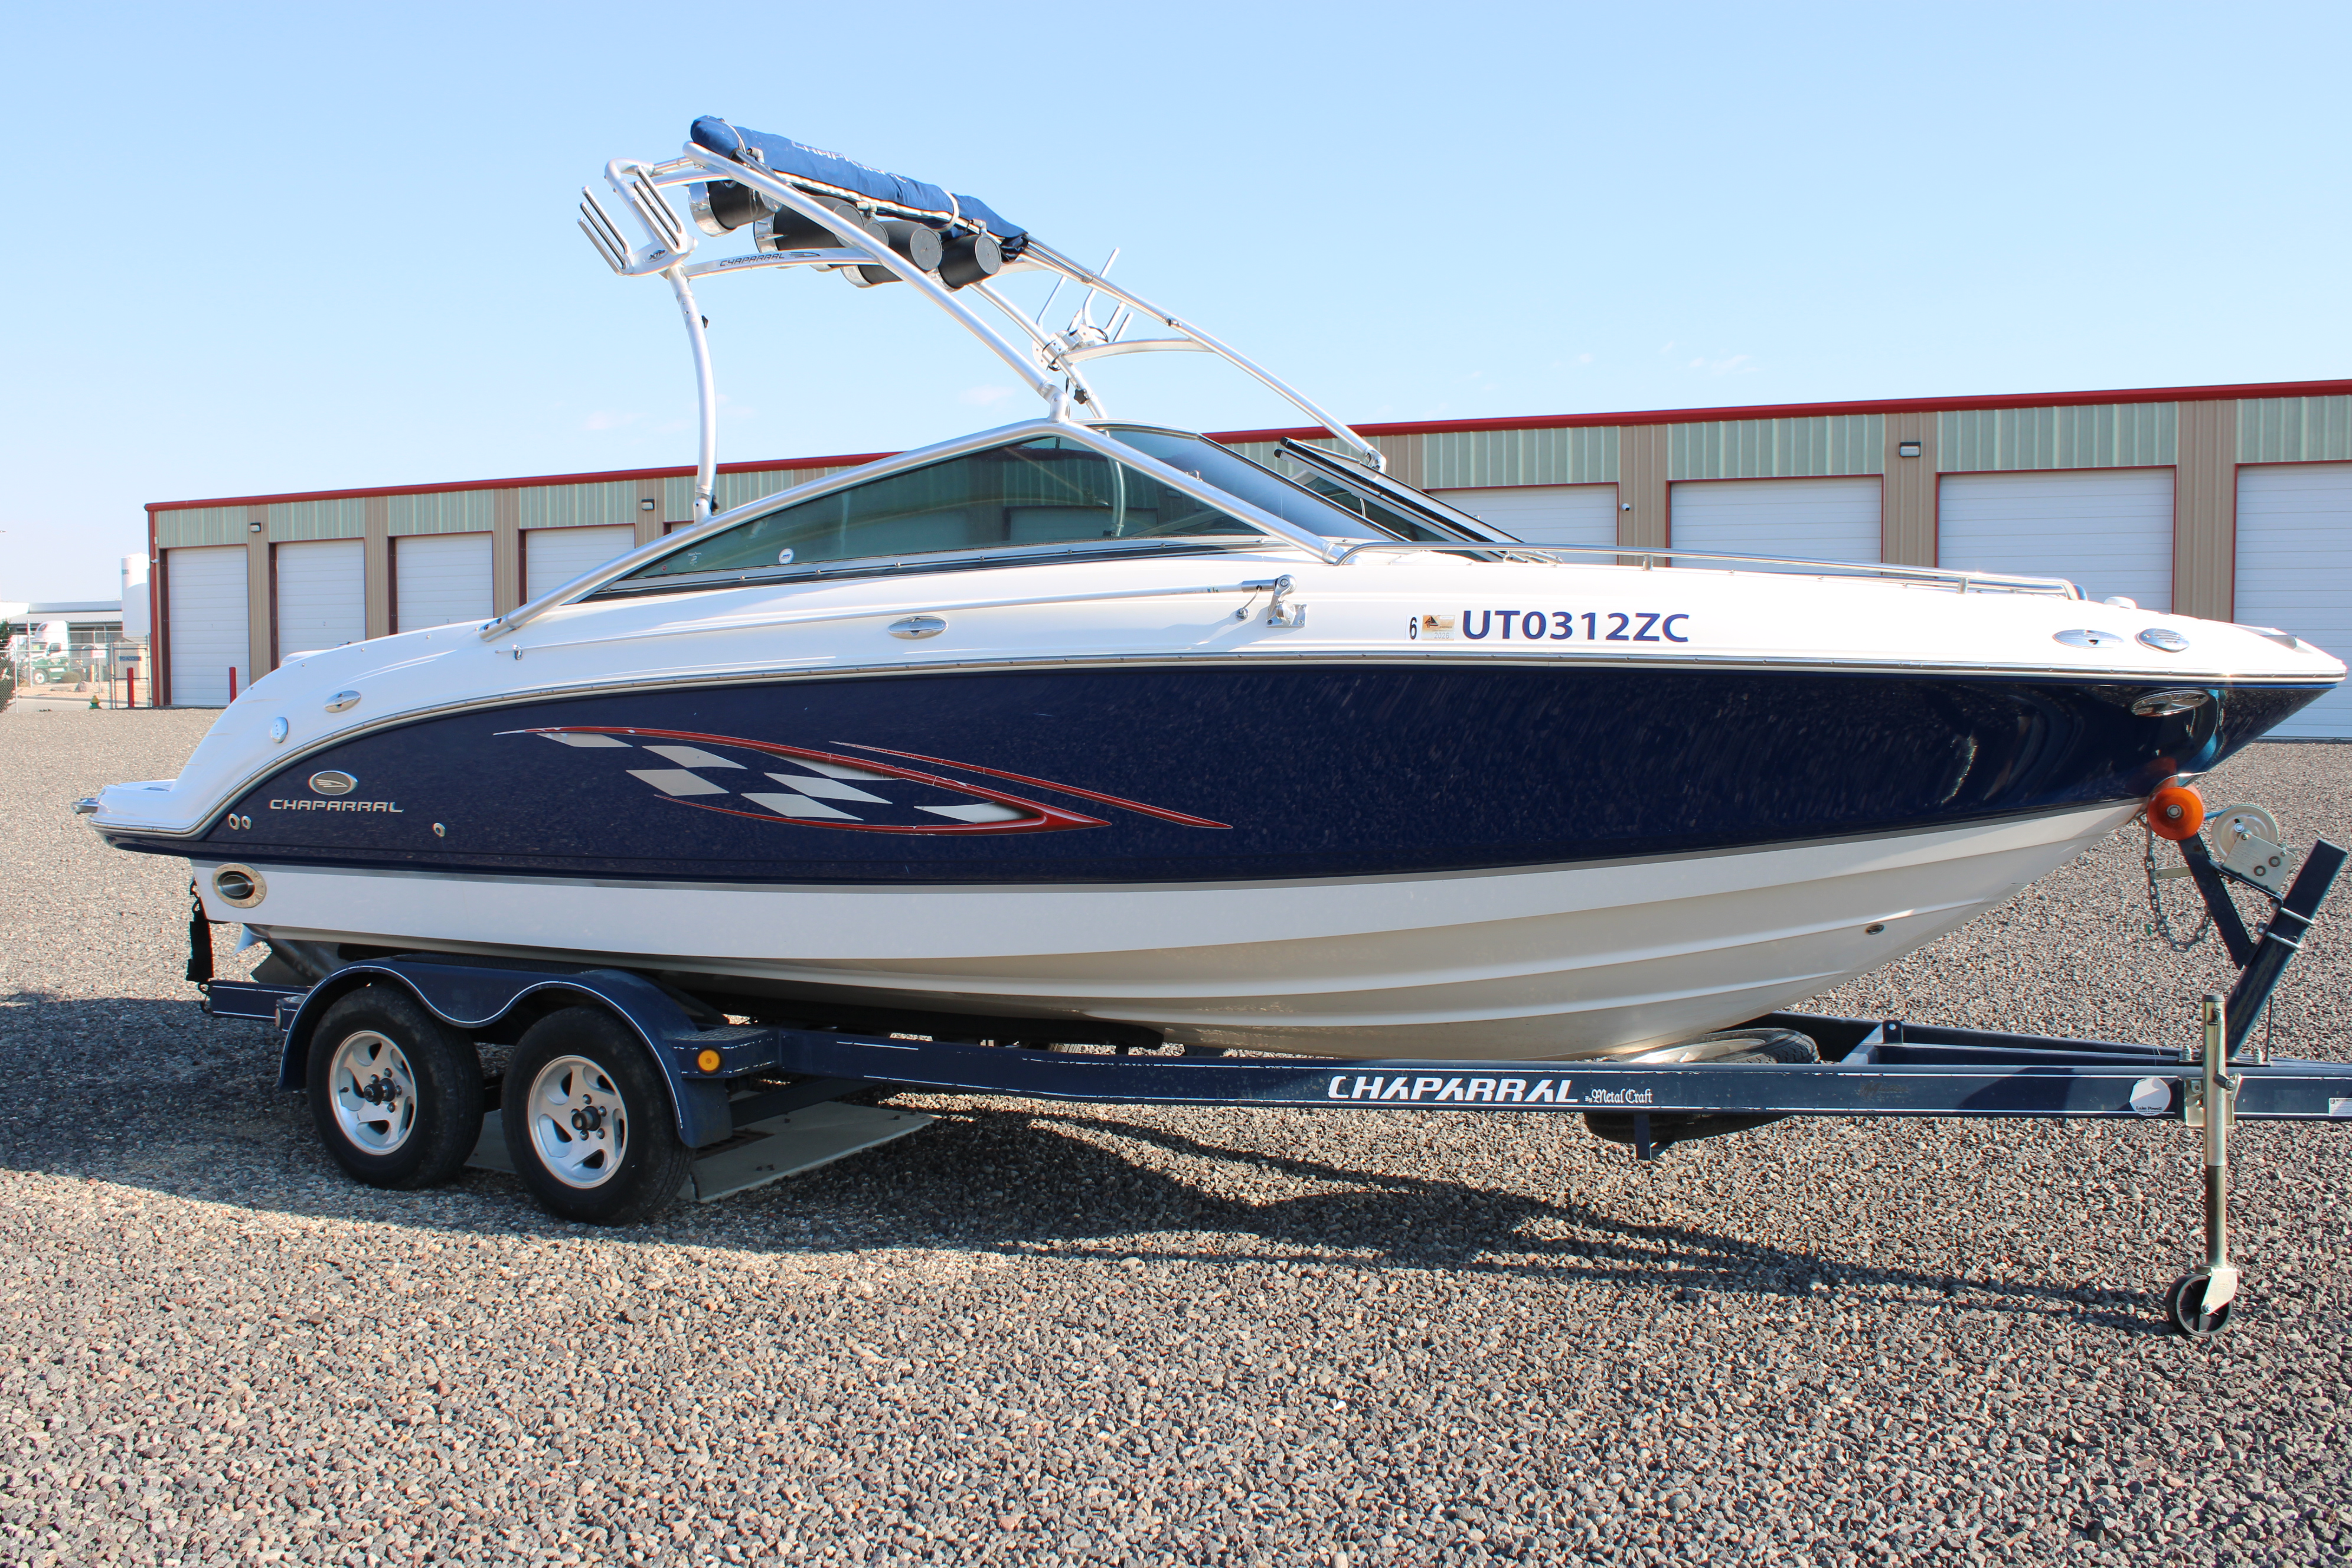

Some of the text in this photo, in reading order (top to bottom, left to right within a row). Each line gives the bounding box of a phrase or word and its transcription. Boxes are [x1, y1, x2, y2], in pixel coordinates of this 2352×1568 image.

[1409, 616, 1417, 640] 6
[1462, 610, 1690, 642] UT0312ZC
[269, 799, 404, 812] CHAPARRAL
[1328, 1075, 1579, 1103] CHAPARRAL
[1591, 1089, 1626, 1103] Metal
[1625, 1088, 1652, 1103] Craft
